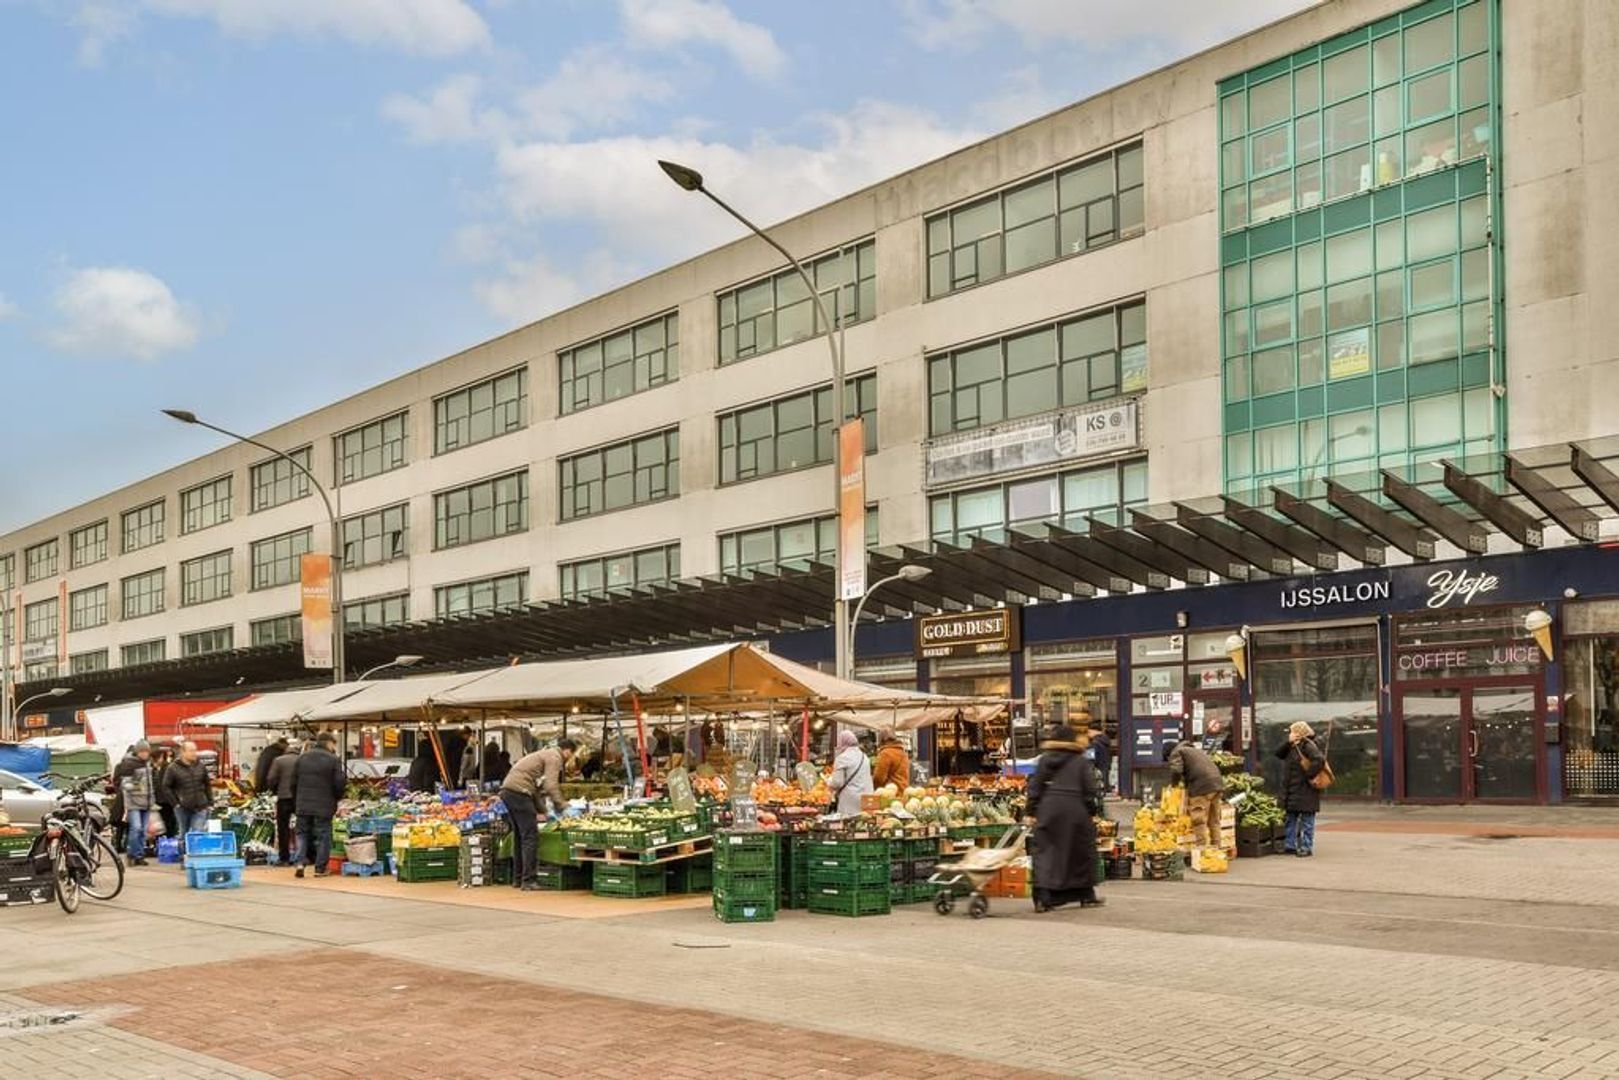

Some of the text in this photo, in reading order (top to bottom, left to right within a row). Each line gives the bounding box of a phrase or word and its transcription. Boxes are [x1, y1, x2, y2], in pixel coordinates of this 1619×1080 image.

[1086, 414, 1105, 432] KS
[1280, 581, 1389, 608] IJSSALON
[923, 617, 1004, 640] GOLD DUST
[1399, 650, 1468, 670] COFFEE
[1486, 645, 1541, 666] JUICE
[1138, 674, 1149, 688] 2
